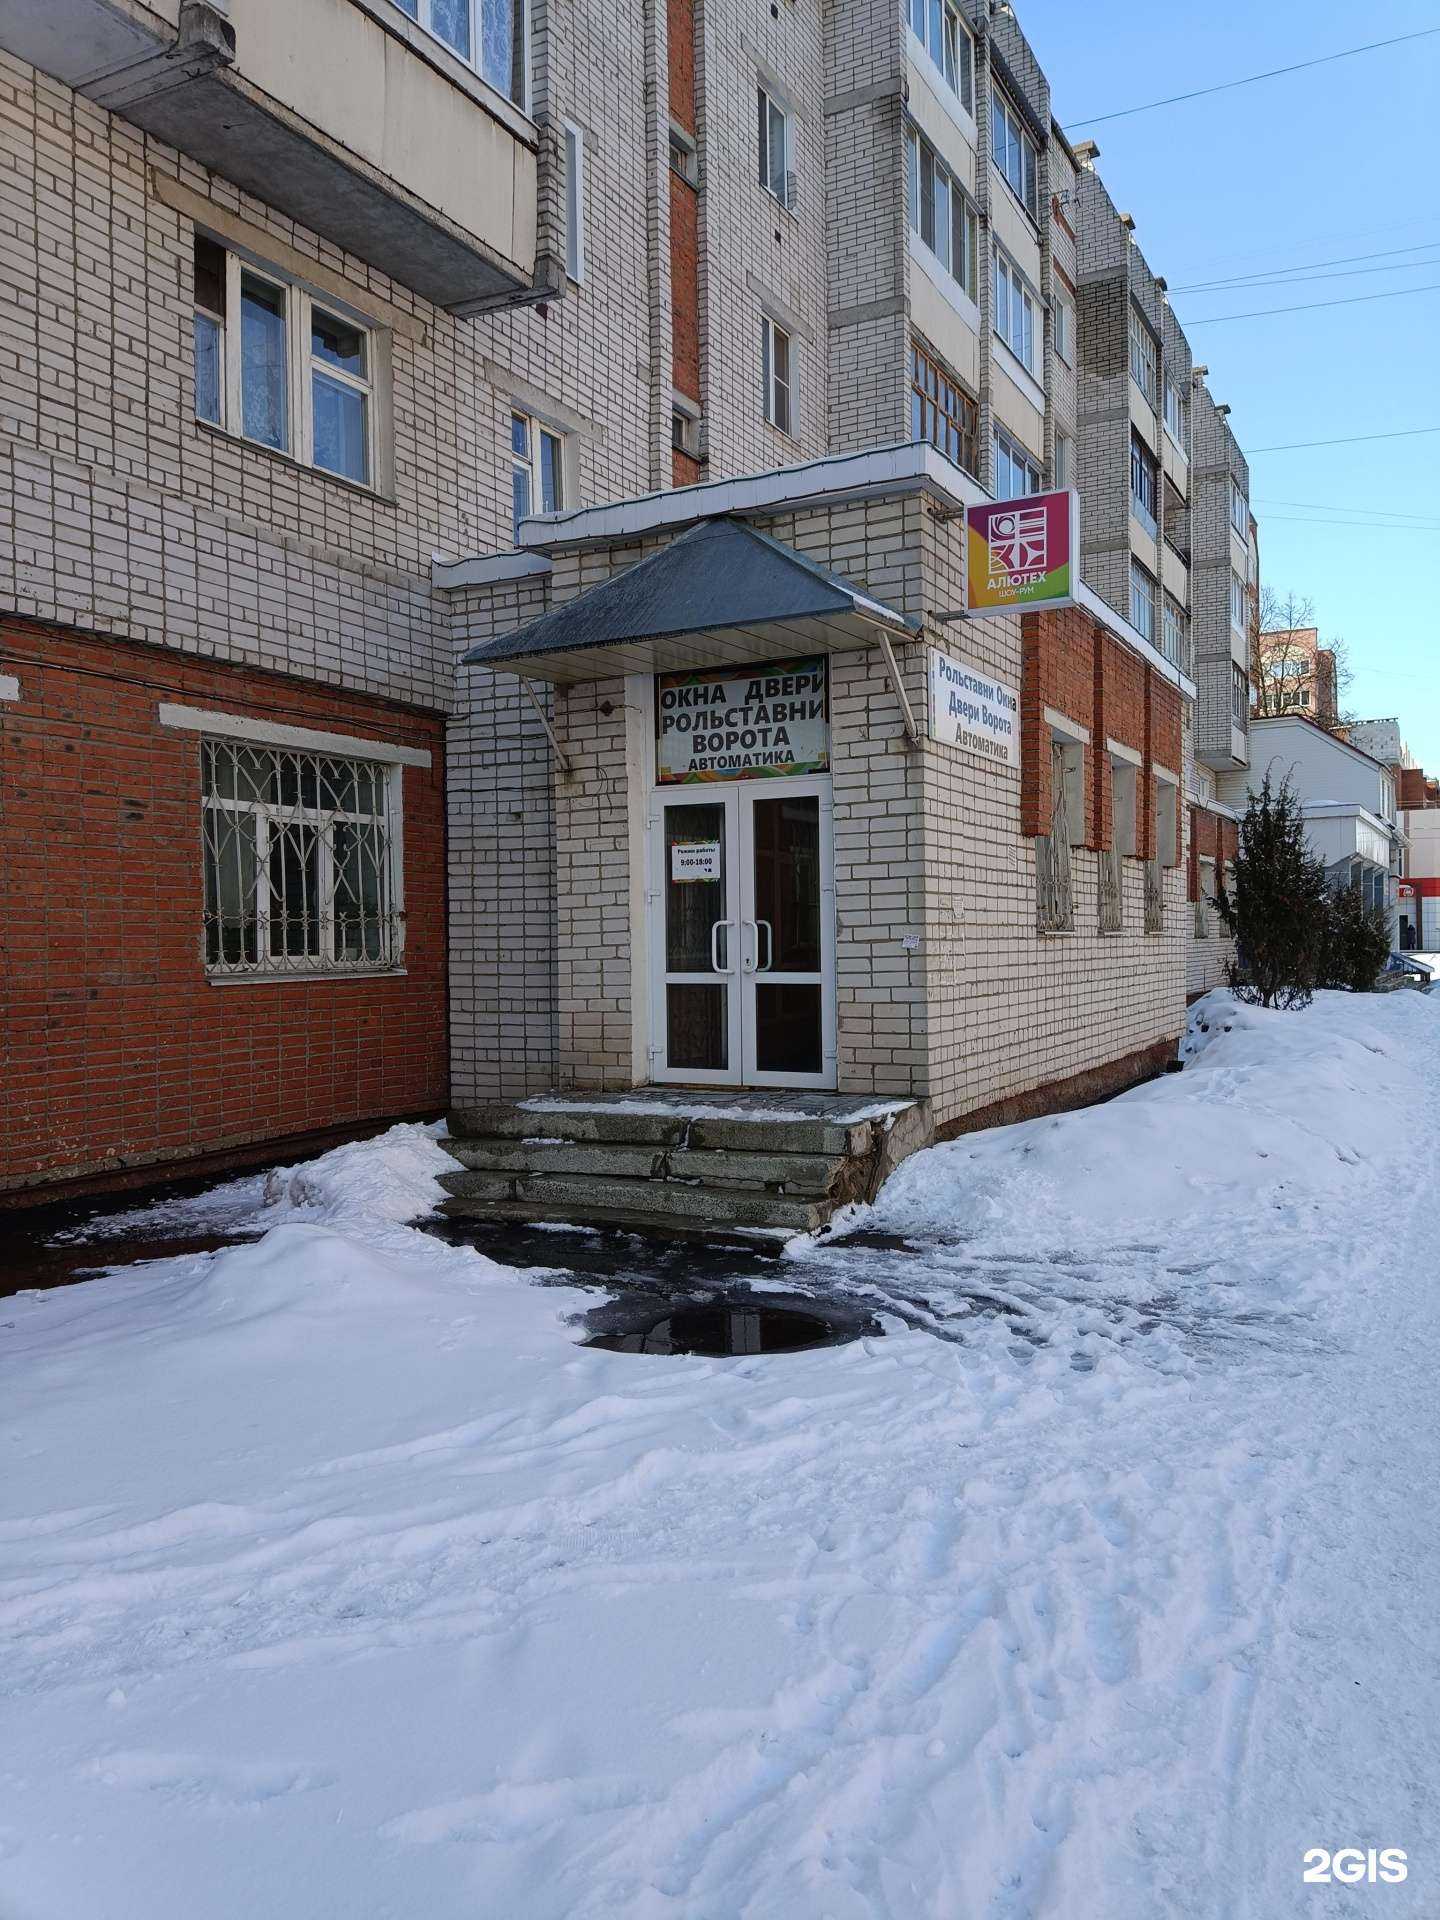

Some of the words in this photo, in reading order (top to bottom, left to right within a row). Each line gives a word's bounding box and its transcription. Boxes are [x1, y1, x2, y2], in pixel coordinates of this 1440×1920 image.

[987, 571, 1047, 590] АЛЮТЕХ
[999, 586, 1034, 597] ШОУ-РУМ
[661, 684, 726, 709] ОКНА
[939, 656, 994, 701] Рольставни
[996, 686, 1017, 712] Окна
[662, 699, 823, 734] РОЛЬСТАВНИ
[949, 690, 980, 724] Двери
[982, 704, 1012, 736] Ворота
[692, 726, 790, 754] ВОРОТА
[955, 722, 1008, 760] Автоматика
[688, 749, 795, 771] АВТОМАТИКА
